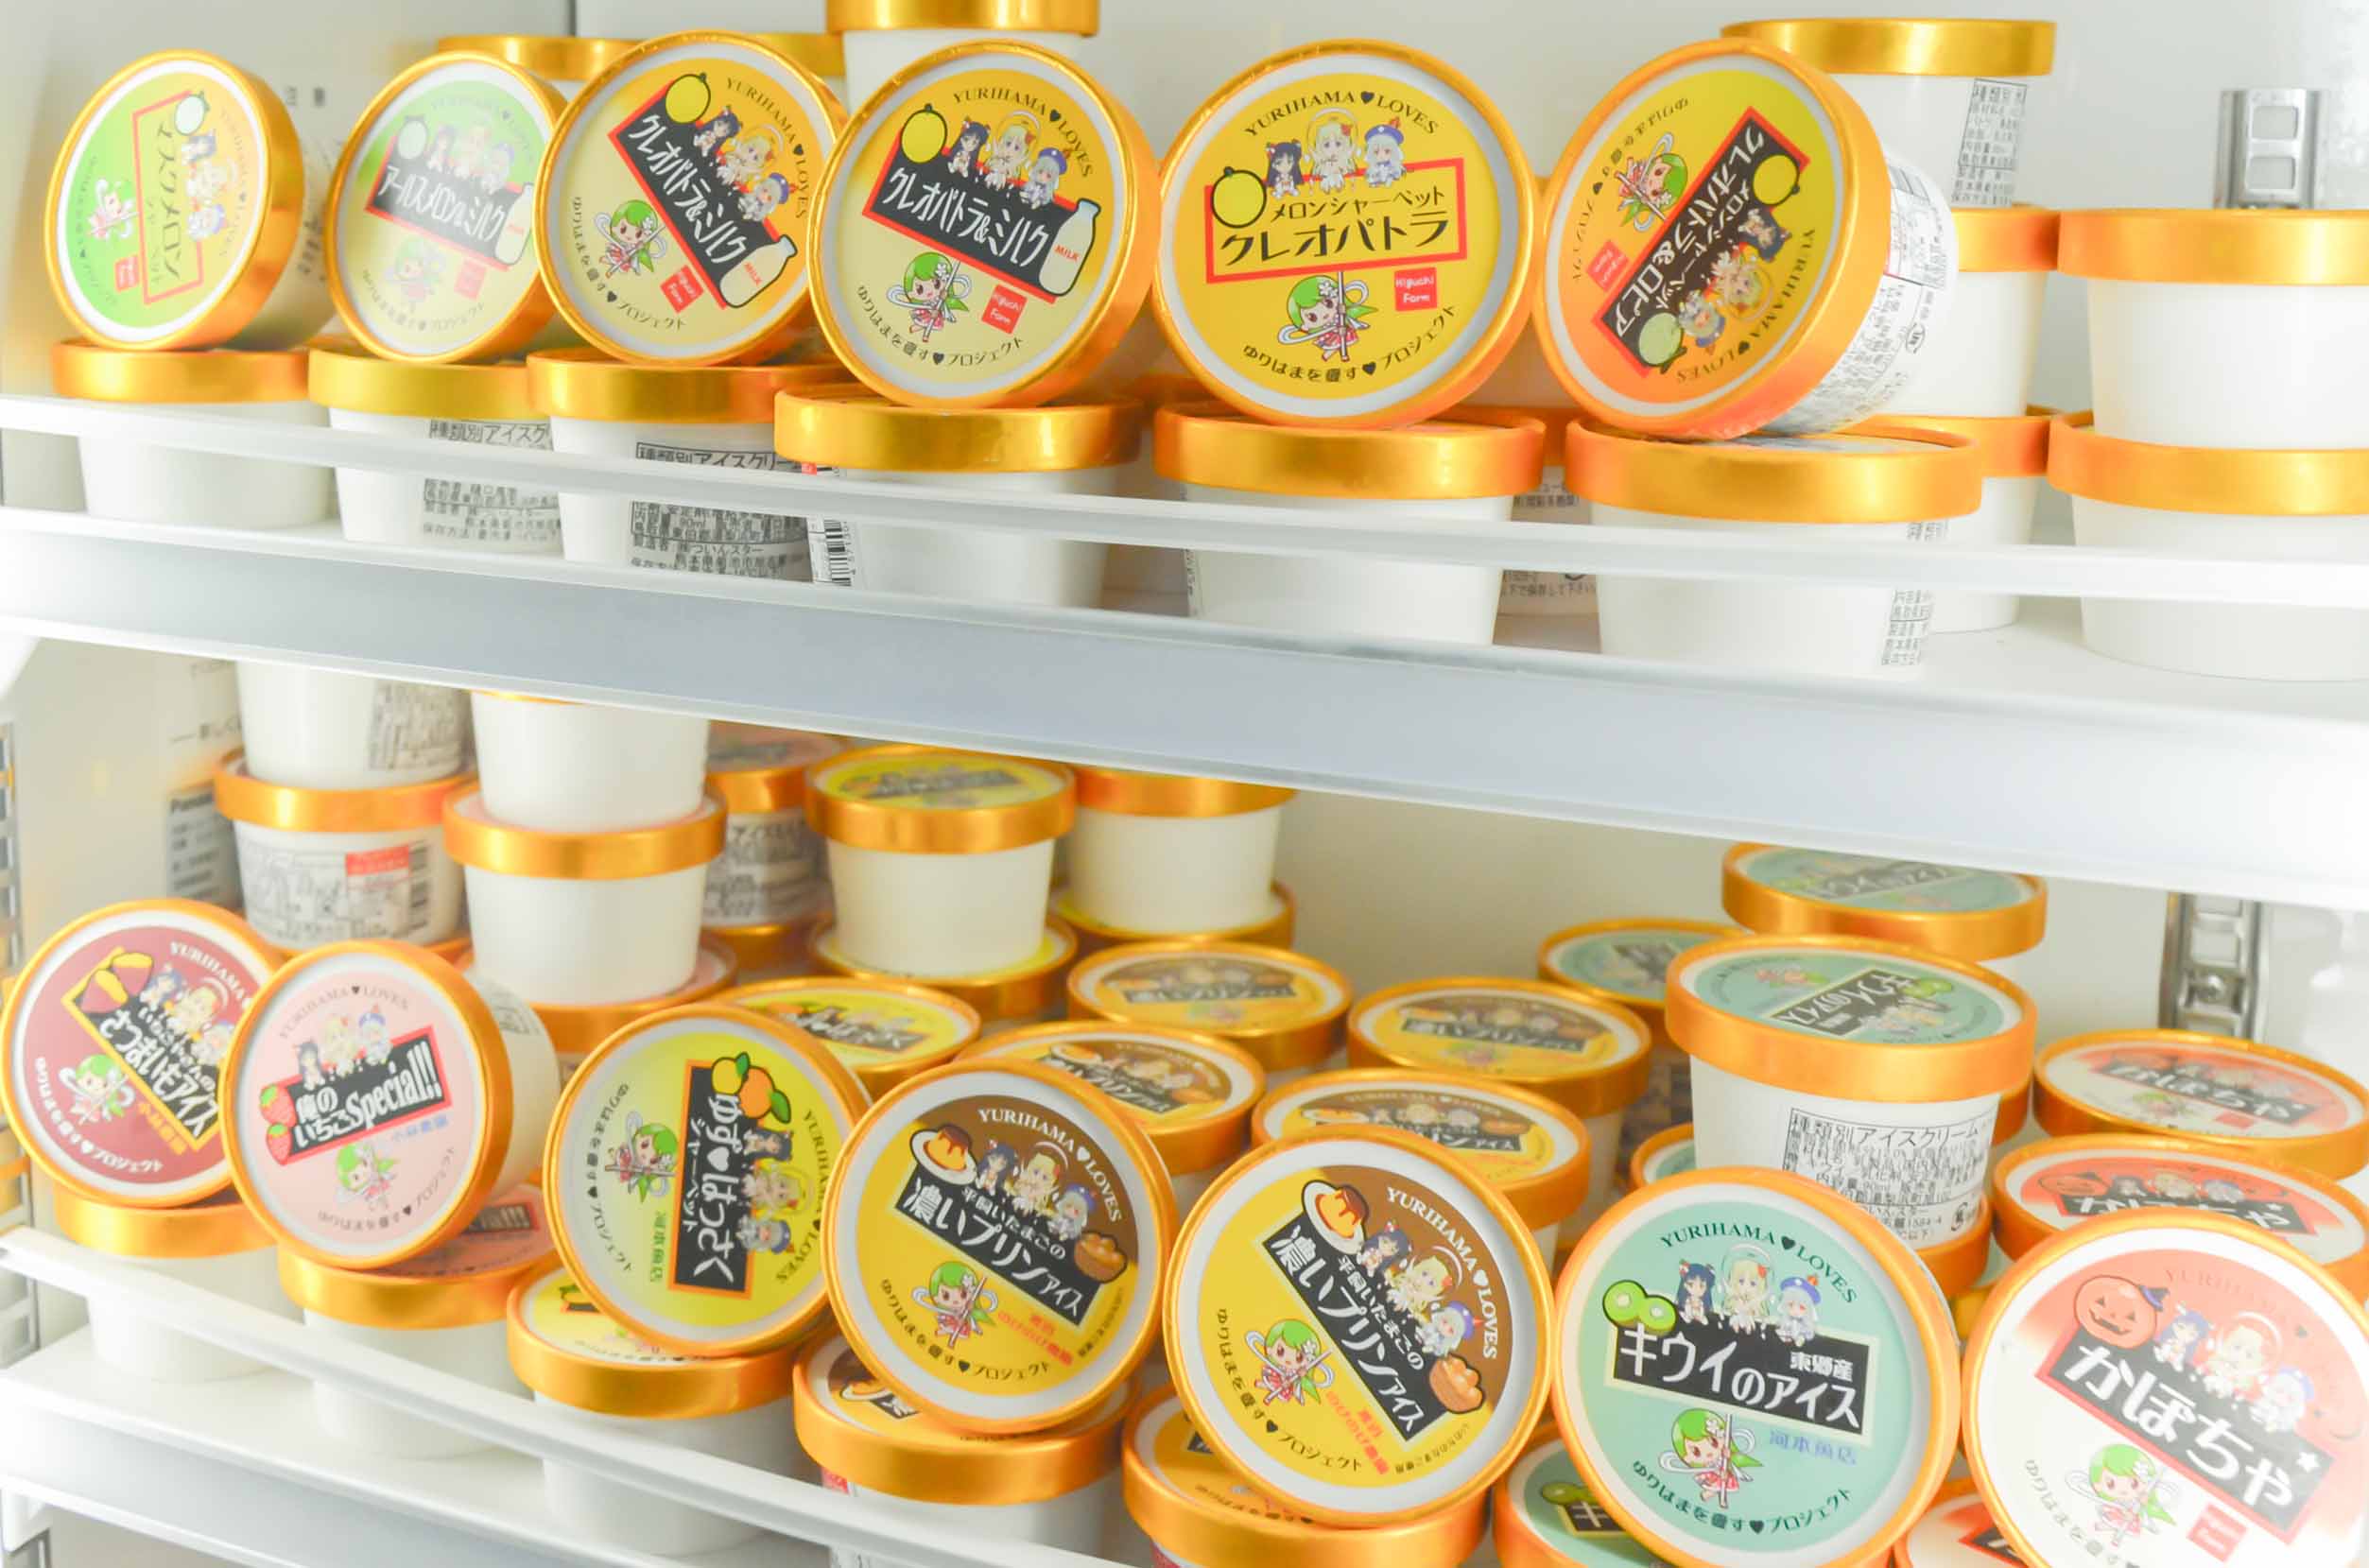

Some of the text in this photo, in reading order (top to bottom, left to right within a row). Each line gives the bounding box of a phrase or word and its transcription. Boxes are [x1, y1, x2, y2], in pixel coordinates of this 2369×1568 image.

[725, 76, 810, 220] YURIHAMA LOVES
[952, 86, 1095, 179] YURIHAMA LOVES
[1243, 90, 1440, 139] YURIHAMA LOVES
[1054, 245, 1081, 262] MILK
[1219, 210, 1449, 267] クレオパトラ
[1270, 185, 1445, 223] メロンシャーベット
[1381, 304, 1460, 371] プロジェクト
[1677, 228, 1816, 384] YURIHAMA LOVES
[682, 1118, 704, 1232] シャーベット
[977, 1107, 1123, 1223] YURIHAMA LOVES
[902, 1176, 1084, 1318] 濃いプリンアイス
[960, 1186, 1066, 1260] 平飼いたまごの
[1386, 1185, 1478, 1272] YURIHAMA
[1476, 1287, 1498, 1361] LOVES
[1659, 1221, 1858, 1305] YURIHAMA LOVES
[1270, 1224, 1426, 1434] 濃いプリンアイス
[1337, 1254, 1425, 1371] 平飼いたまごの
[1619, 1322, 1861, 1429] キウイのアイス
[1790, 1350, 1855, 1384] 東郷産
[2064, 1343, 2295, 1510] かぼちゃ
[1769, 1487, 1855, 1535] プロジェクト
